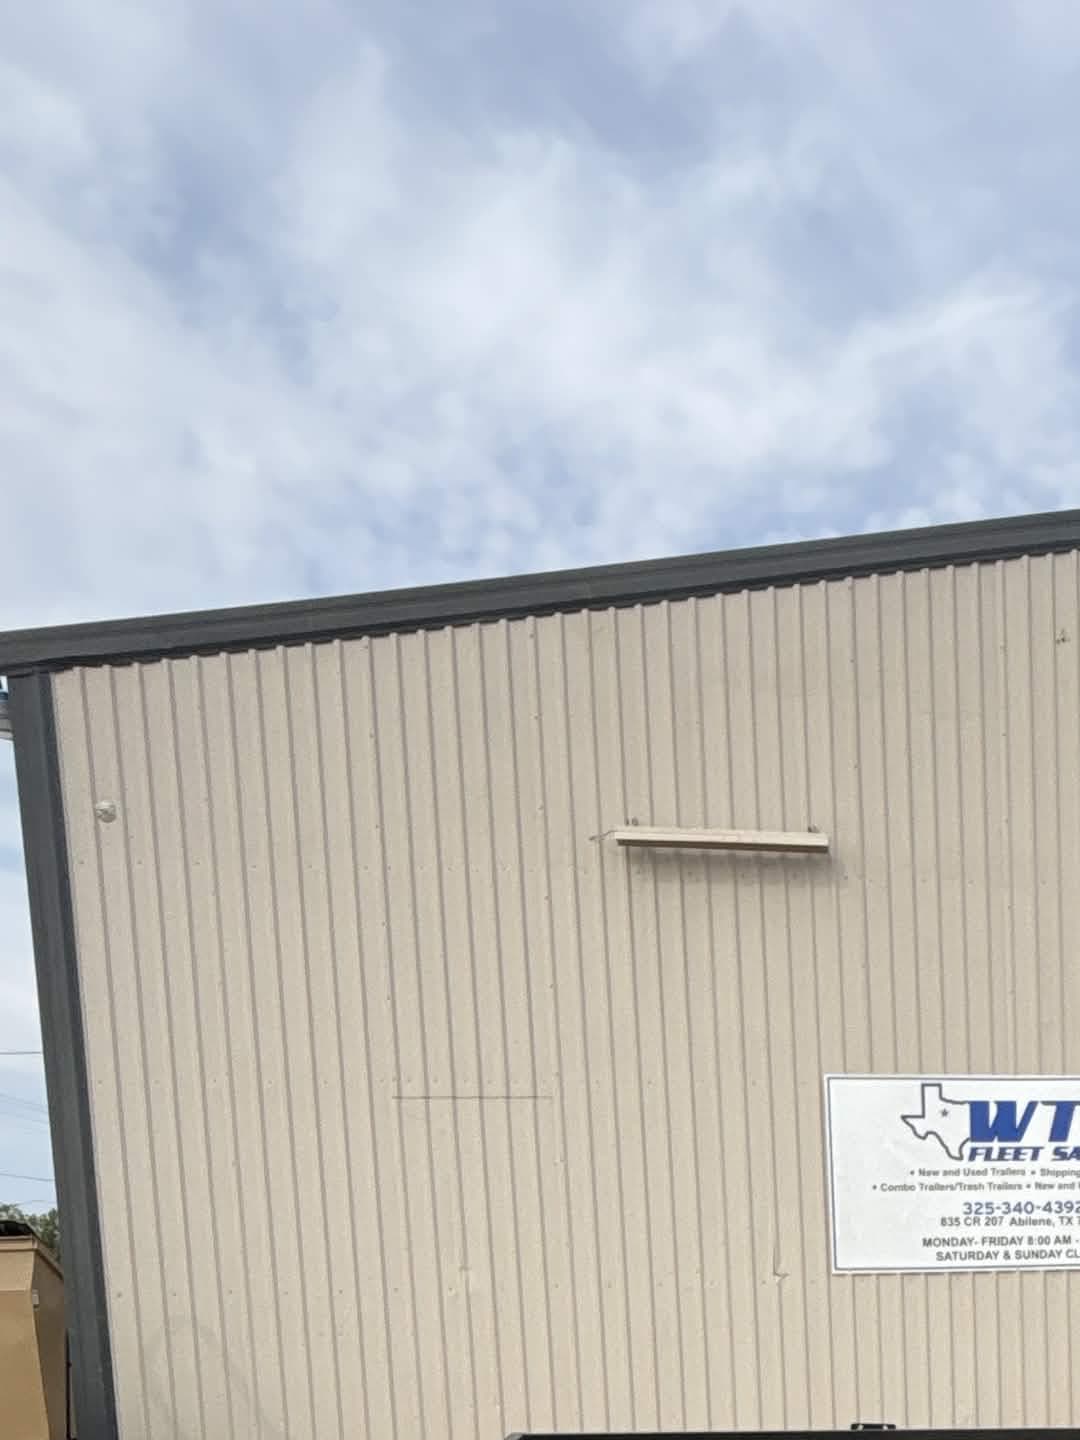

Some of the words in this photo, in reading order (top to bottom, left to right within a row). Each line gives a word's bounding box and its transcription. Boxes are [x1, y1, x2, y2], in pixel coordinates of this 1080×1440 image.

[968, 1146, 1044, 1161] FLEET
[918, 1168, 939, 1176] New
[942, 1168, 960, 1176] and
[963, 1168, 988, 1176] Used
[991, 1167, 1026, 1176] Trailers
[880, 1183, 916, 1191] Combo
[988, 1182, 1023, 1190] Trailers
[1035, 1181, 1056, 1190] New
[1058, 1181, 1076, 1190] and
[964, 1217, 981, 1227] CR
[985, 1217, 1004, 1226] 207
[1009, 1217, 1056, 1228] Abilene,
[1059, 1216, 1073, 1225] TX
[981, 1236, 1024, 1247] FRIDAY
[1027, 1236, 1051, 1246] 8:00
[1053, 1235, 1071, 1245] AM
[936, 1250, 999, 1261] SATURDAY
[1003, 1250, 1011, 1260] &
[1014, 1249, 1062, 1260] SUNDAY
